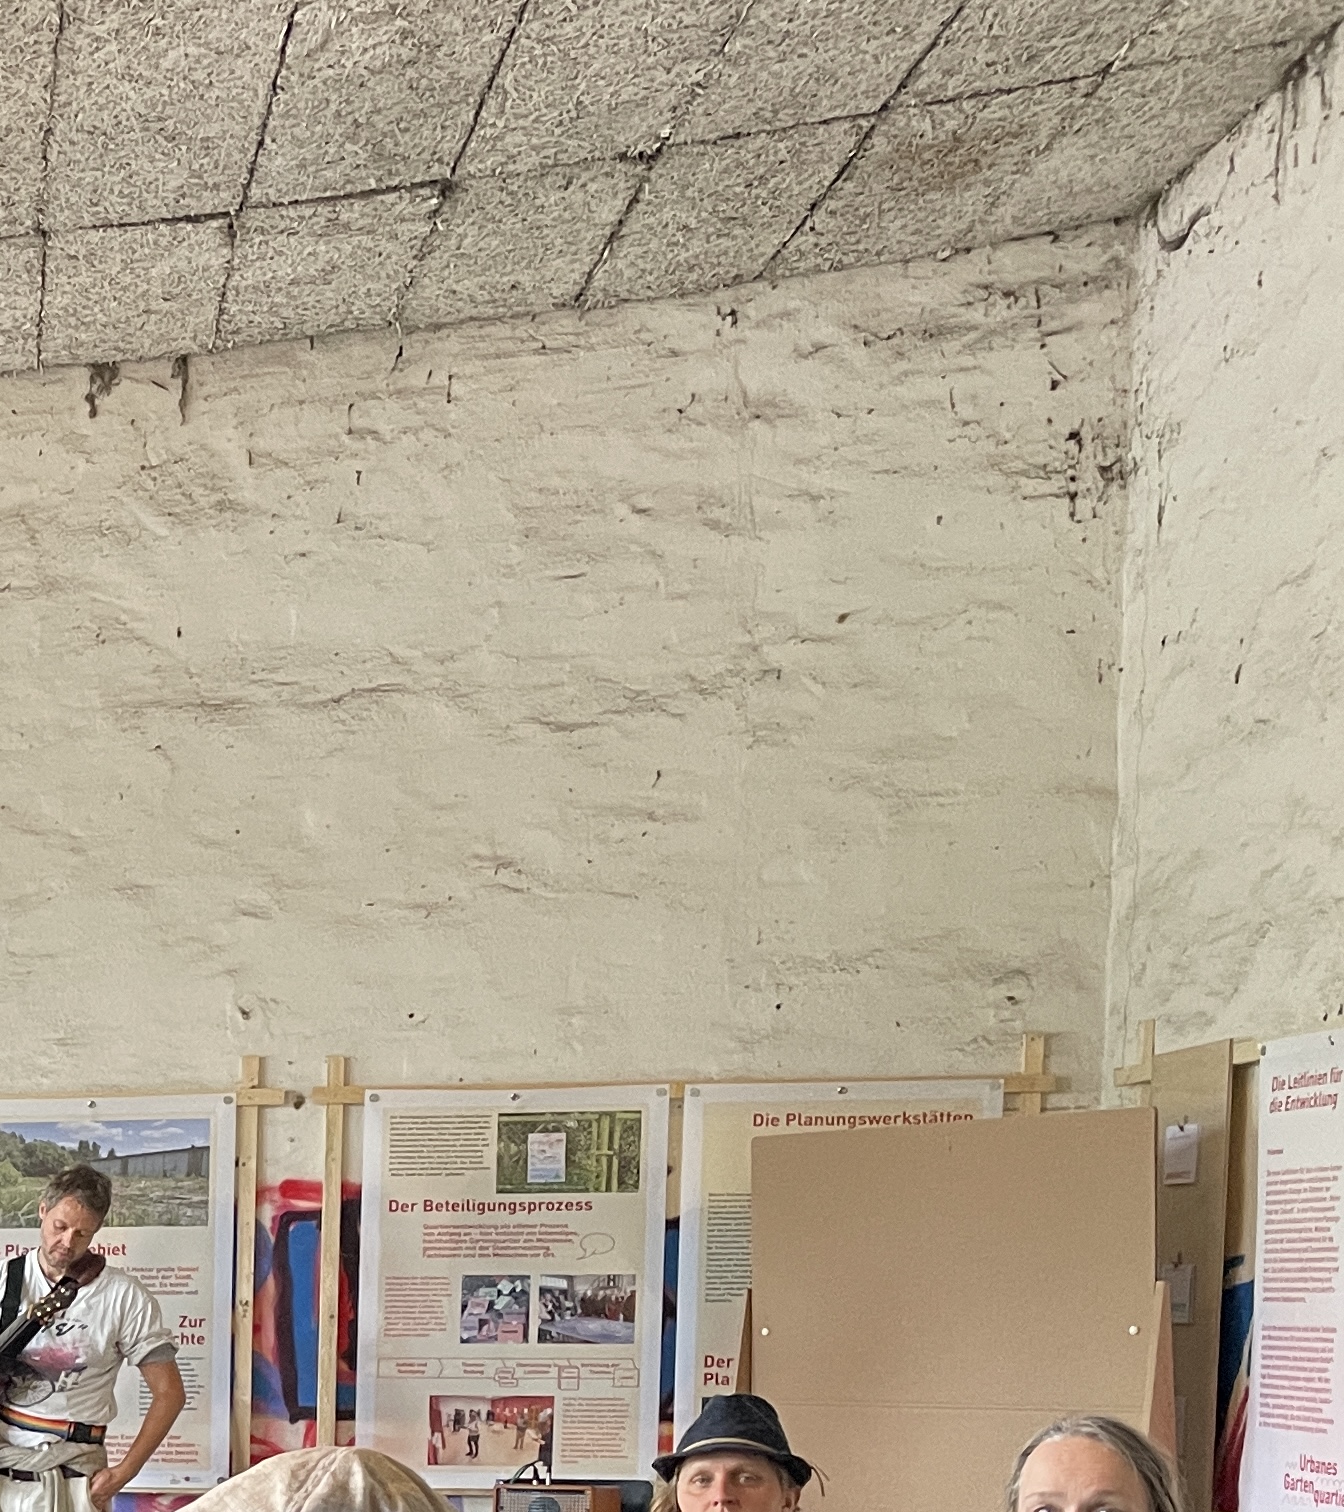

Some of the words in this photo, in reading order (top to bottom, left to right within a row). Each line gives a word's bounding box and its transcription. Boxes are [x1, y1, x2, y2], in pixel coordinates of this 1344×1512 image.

[1271, 1075, 1287, 1093] Die
[1269, 1098, 1283, 1113] die
[1284, 1092, 1339, 1111] Entwicklung
[753, 1113, 780, 1127] Die
[388, 1199, 418, 1213] Der
[423, 1198, 593, 1215] Beteiligungsprozess
[179, 1315, 206, 1328] Zur
[704, 1355, 734, 1368] Der
[1299, 1453, 1338, 1475] Urbanes
[1284, 1473, 1314, 1494] Garten
